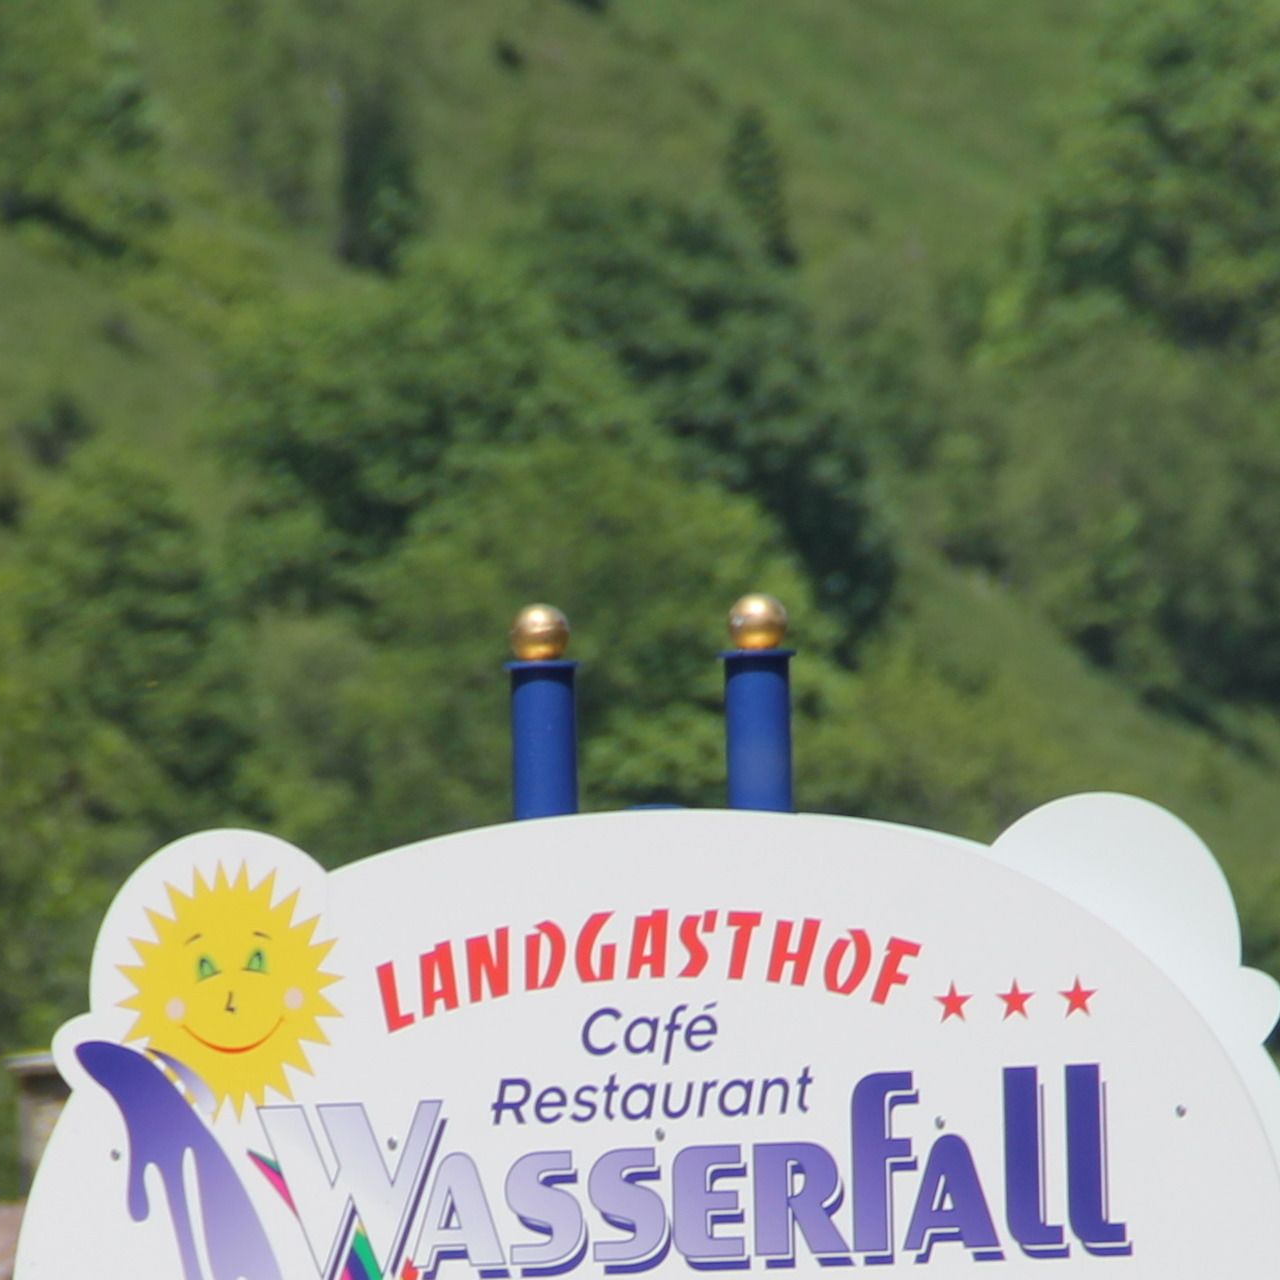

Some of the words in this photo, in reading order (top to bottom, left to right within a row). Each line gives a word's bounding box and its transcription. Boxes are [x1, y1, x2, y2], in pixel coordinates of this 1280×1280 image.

[376, 908, 921, 1034] LANDGASTHOF
[581, 1002, 719, 1065] Café
[490, 1066, 814, 1126] Restaurant
